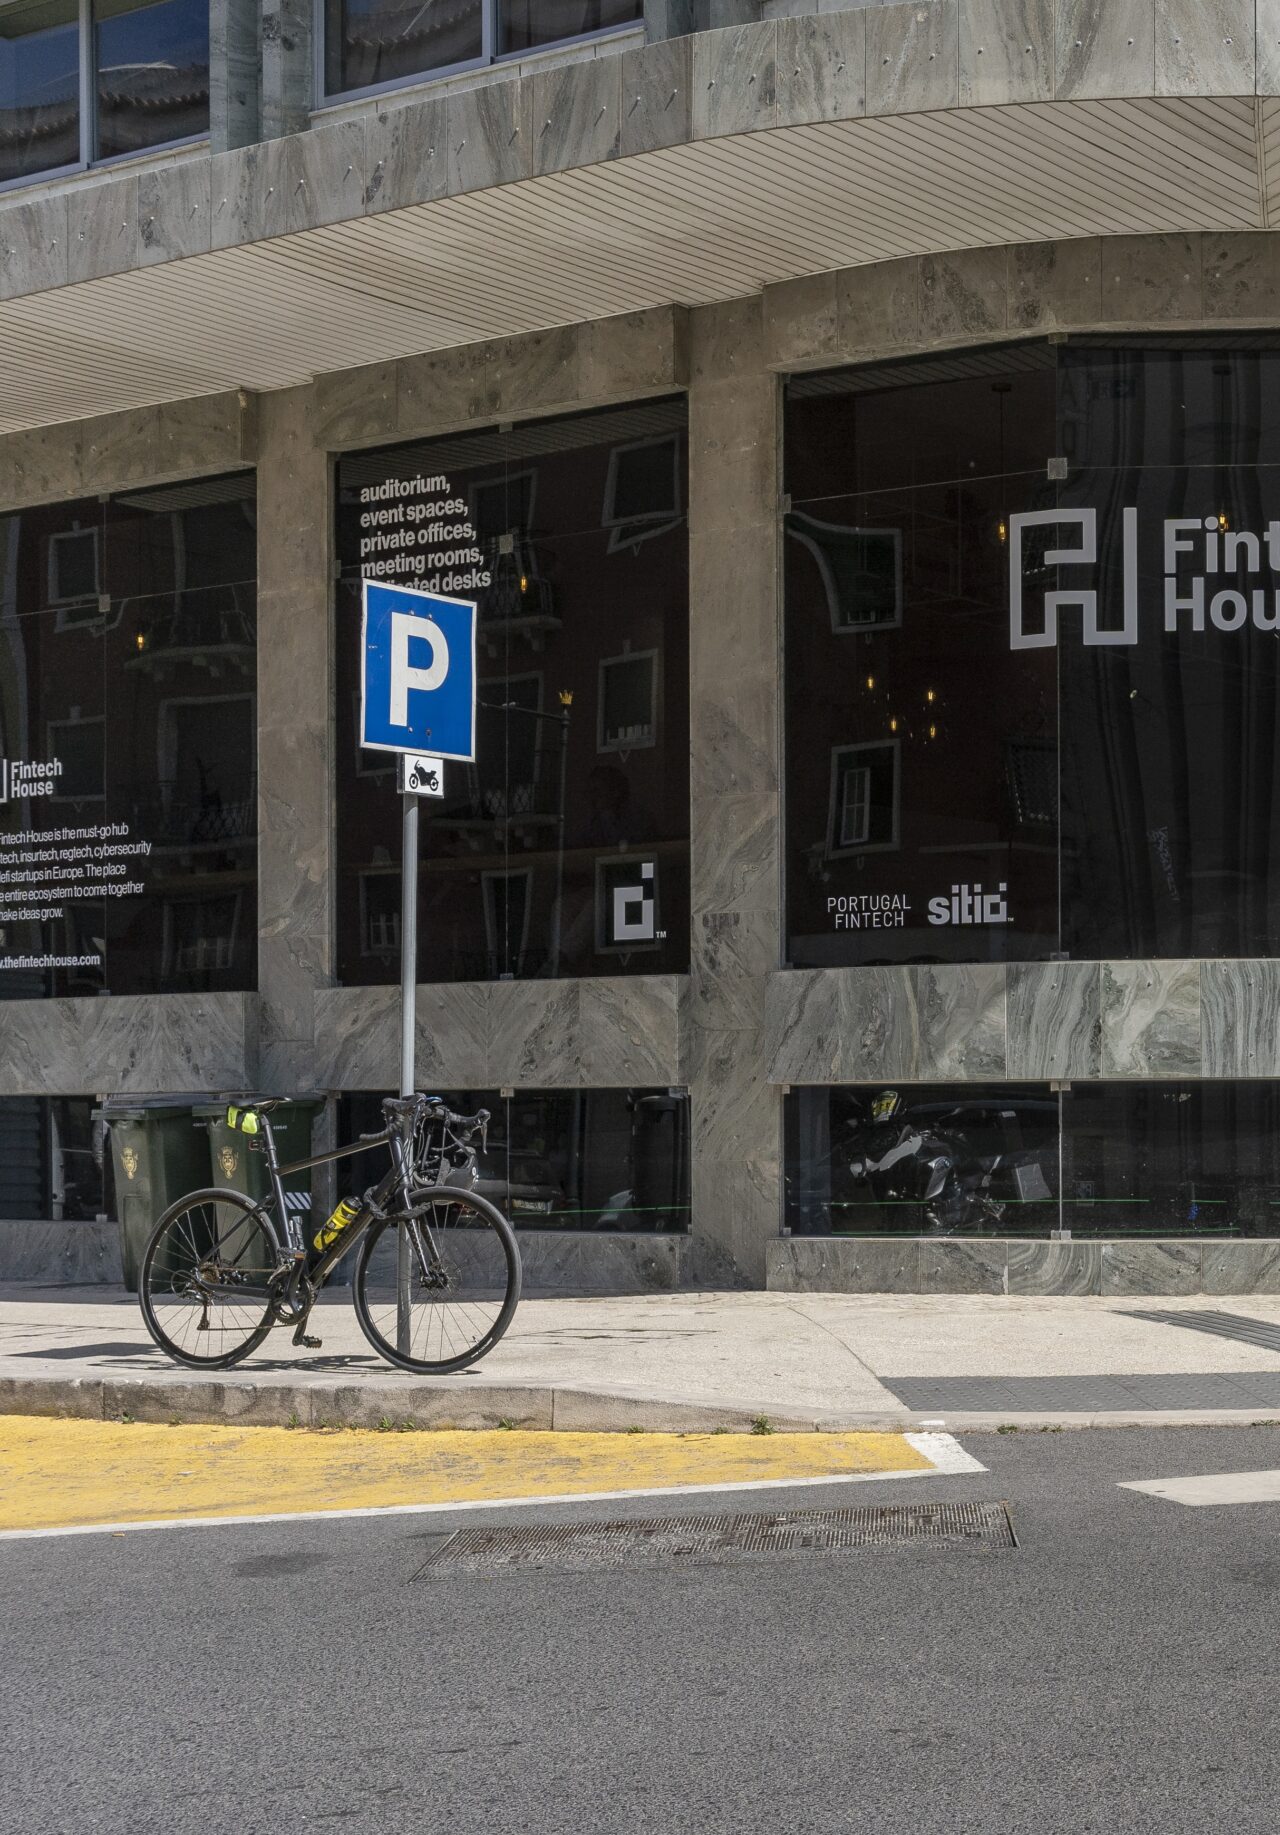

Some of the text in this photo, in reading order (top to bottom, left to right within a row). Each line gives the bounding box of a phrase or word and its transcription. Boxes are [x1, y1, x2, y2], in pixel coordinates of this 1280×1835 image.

[360, 474, 450, 503] auditorium,
[360, 498, 468, 527] event spaces,
[360, 522, 476, 557] private offices,
[361, 547, 484, 577] meeting rooms,
[442, 568, 491, 592] desks
[389, 611, 449, 727] P
[11, 758, 62, 780] Fintech
[11, 780, 54, 798] House
[27, 829, 54, 844] House
[54, 828, 62, 841] is
[62, 828, 76, 840] the
[76, 825, 111, 840] must-go
[112, 822, 129, 836] hub
[20, 848, 59, 862] insurtech,
[60, 845, 93, 860] regtech,
[94, 840, 152, 859] cybersecurity
[11, 868, 44, 883] startups
[44, 867, 52, 880] in
[53, 866, 85, 880] Europe.
[85, 864, 102, 877] The
[103, 863, 126, 878] place
[4, 889, 28, 902] entire
[28, 885, 74, 901] ecosystem
[74, 885, 83, 897] to
[83, 885, 107, 897] come
[108, 881, 144, 897] together
[18, 908, 40, 920] ideas
[41, 907, 63, 921] grow.
[827, 894, 912, 912] PORTUGAL
[835, 911, 904, 929] FINTECH
